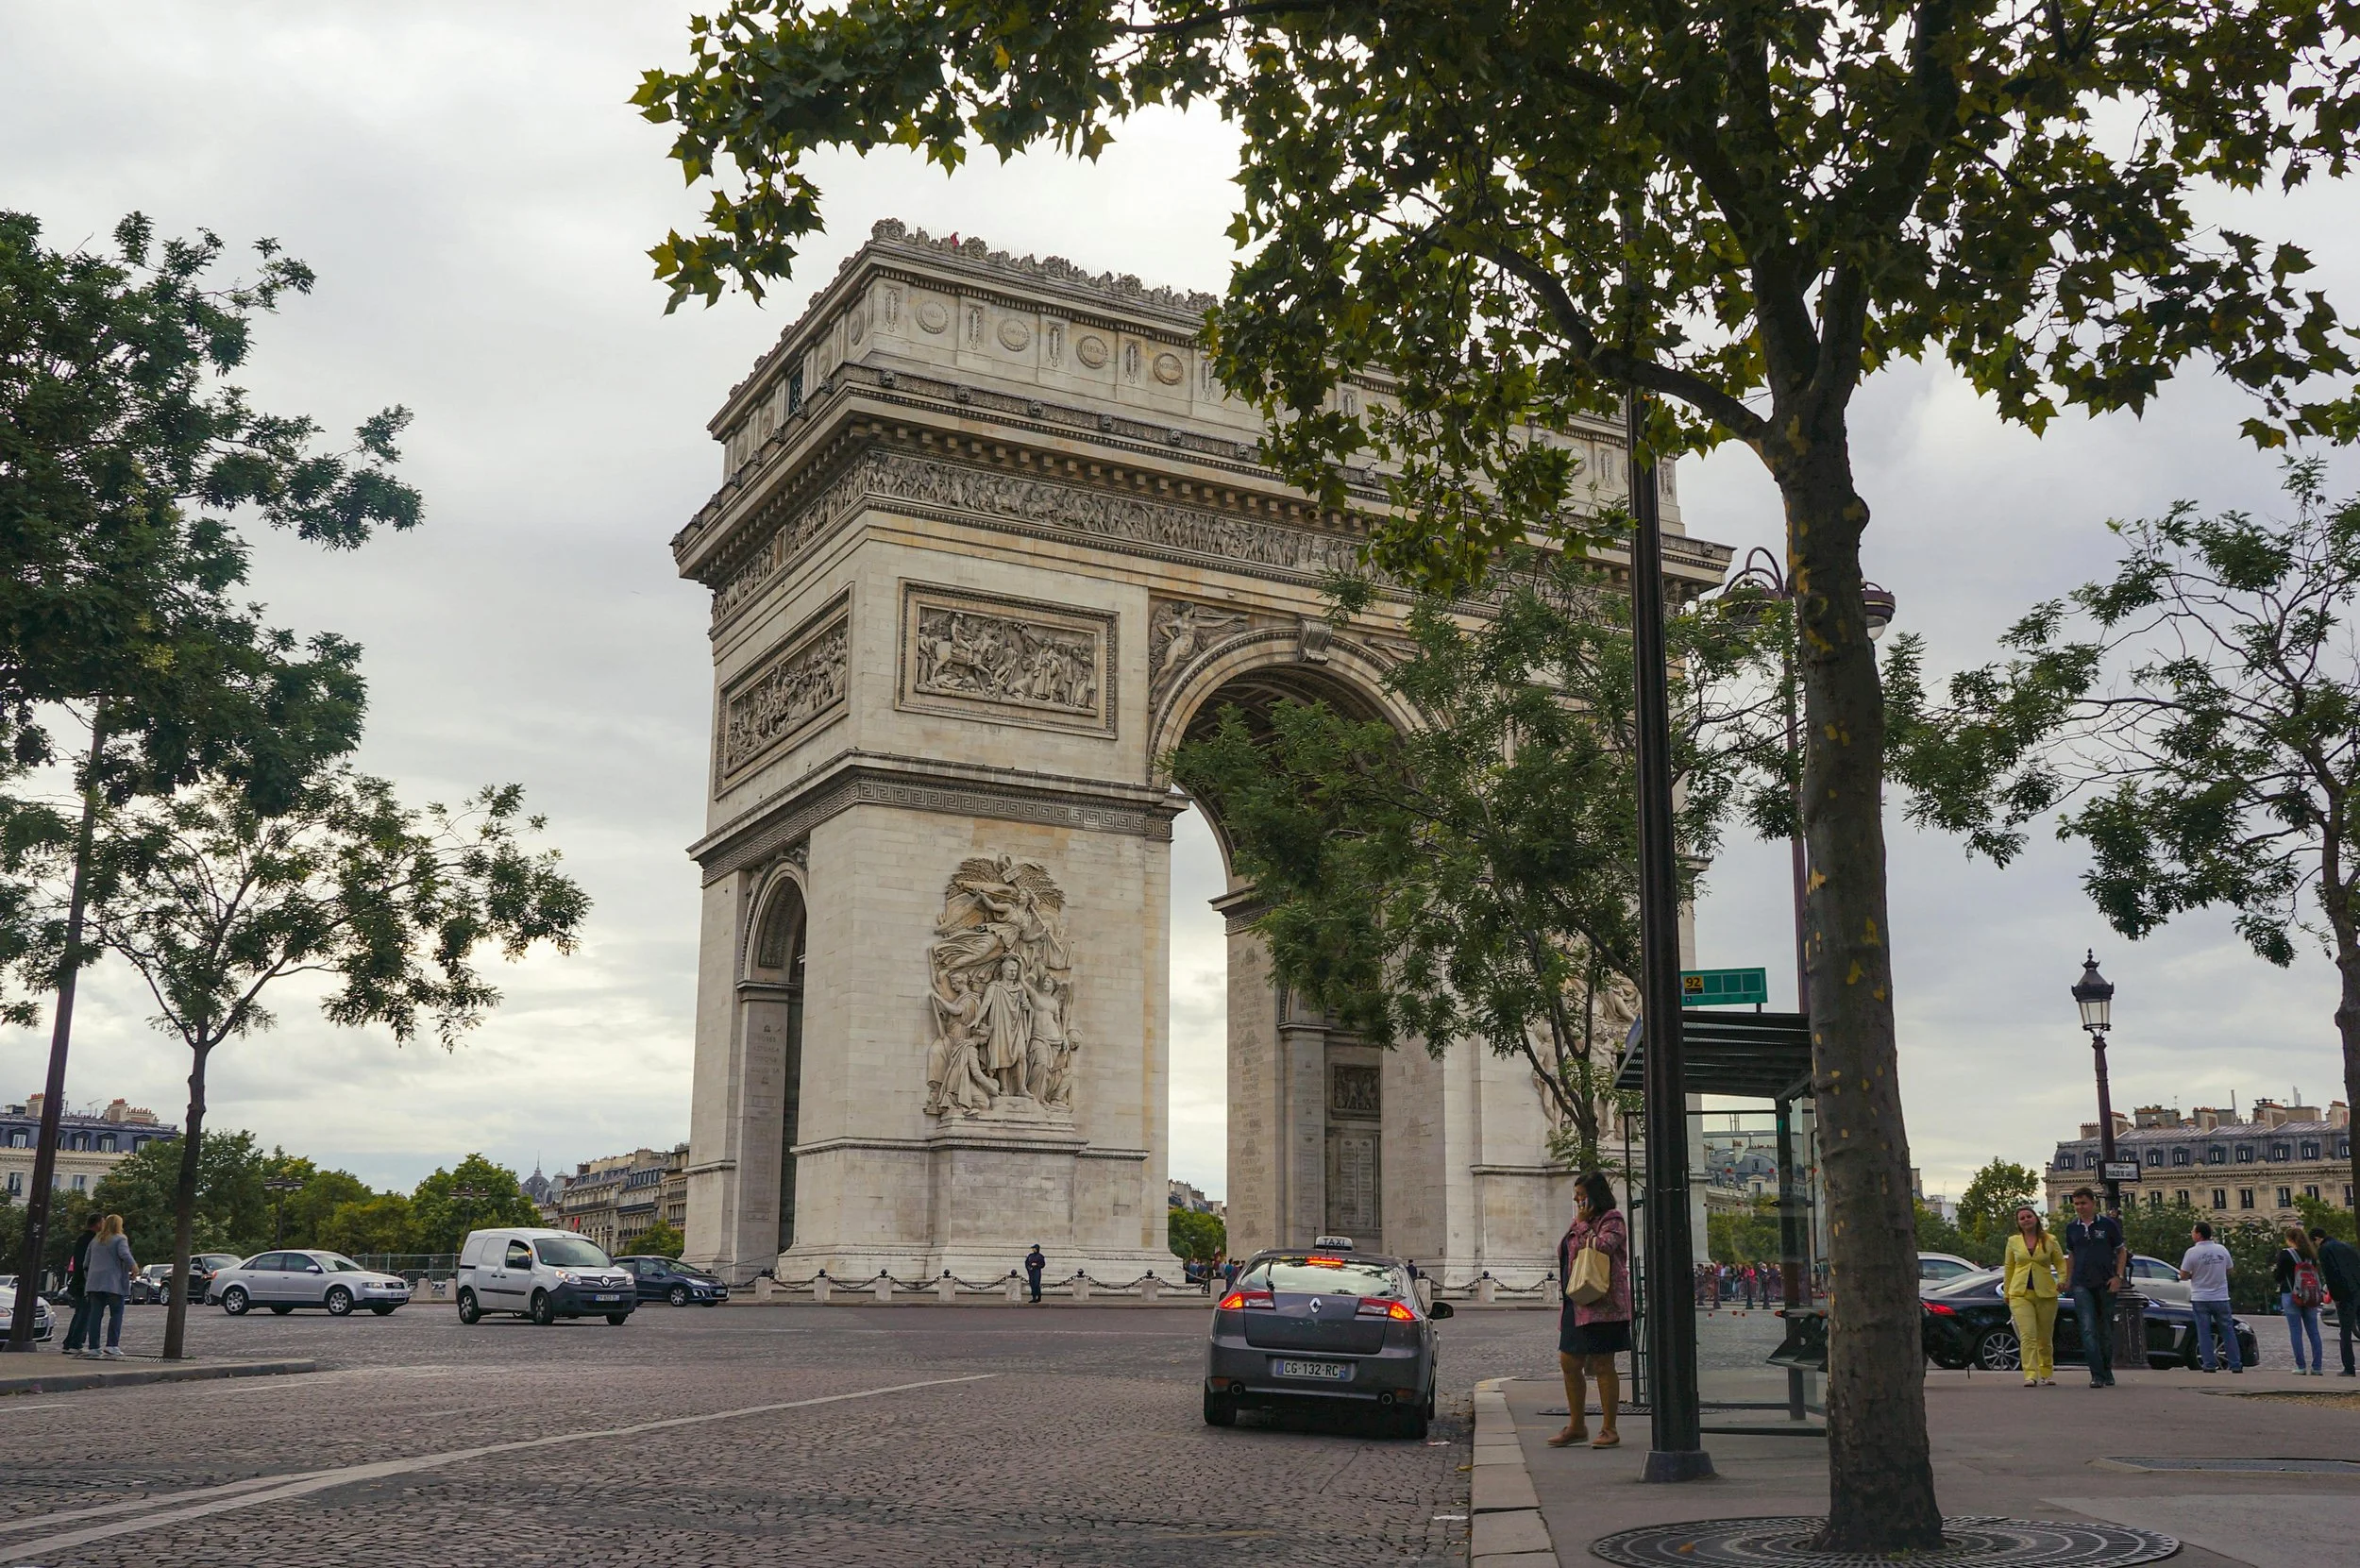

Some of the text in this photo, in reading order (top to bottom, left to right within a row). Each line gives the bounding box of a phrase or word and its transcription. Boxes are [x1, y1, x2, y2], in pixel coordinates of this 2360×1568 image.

[1686, 977, 1701, 987] 92
[1323, 1238, 1345, 1246] TAXI
[1284, 1361, 1340, 1377] CG-132-RC
